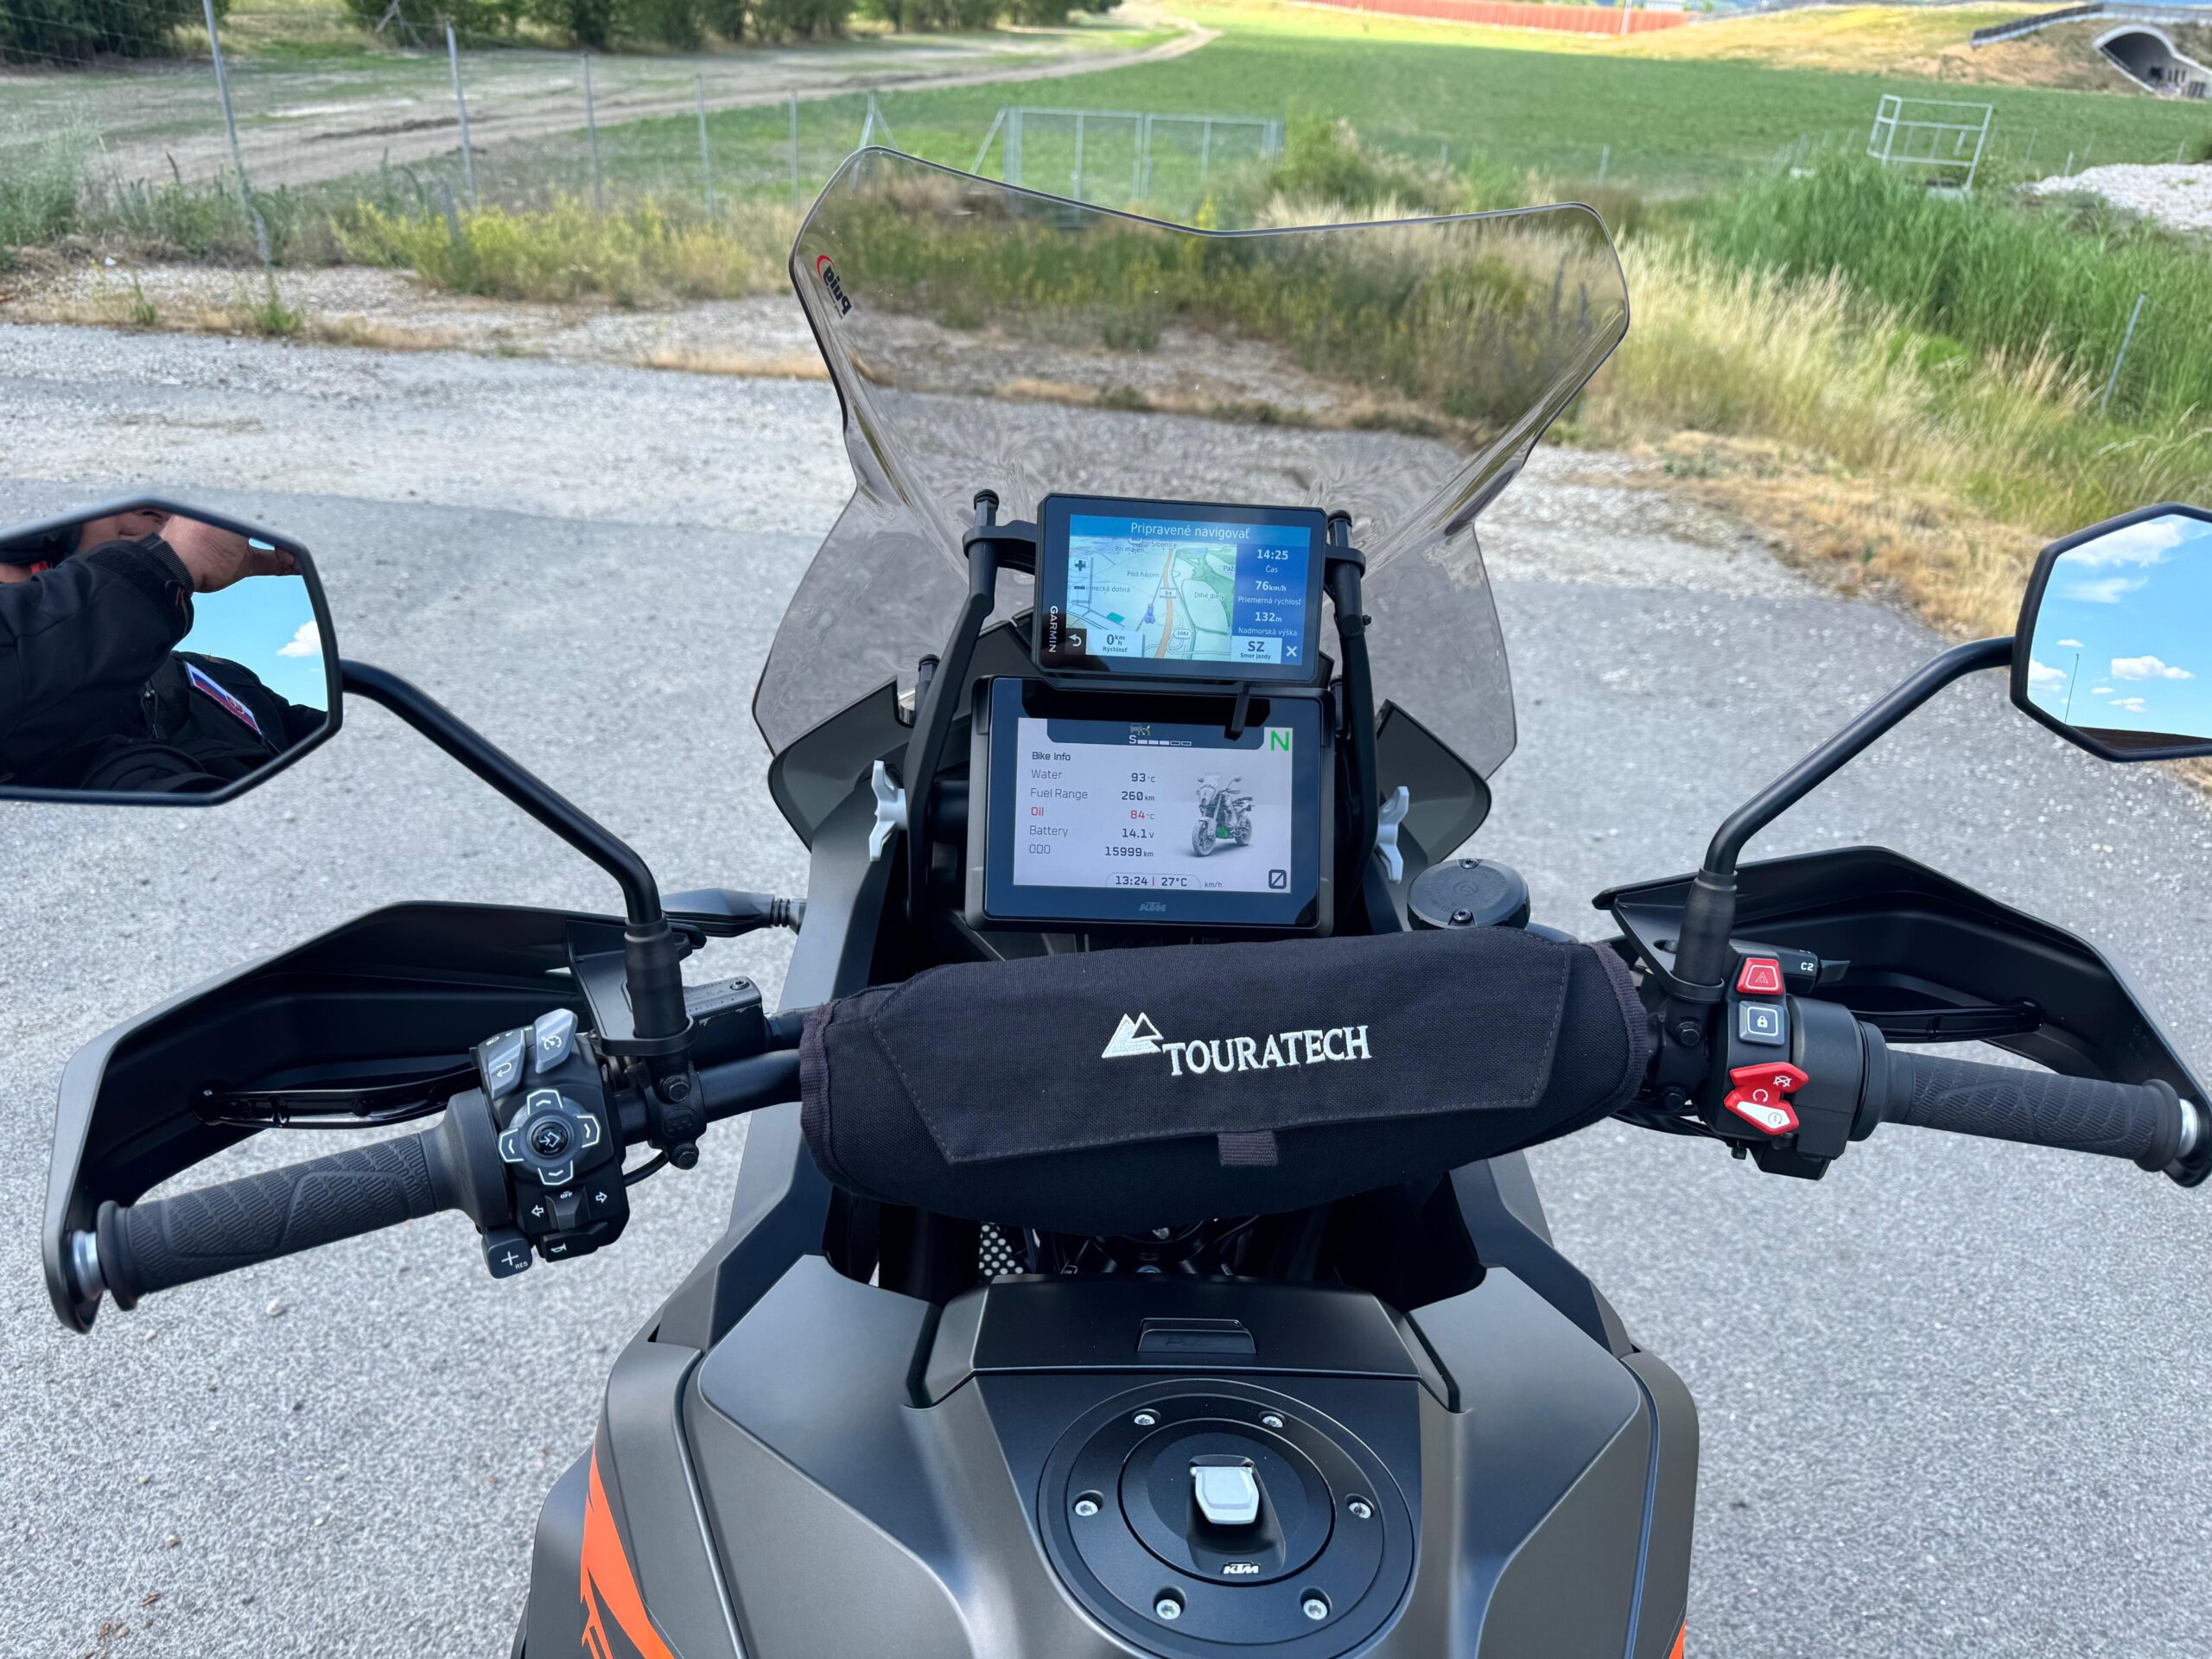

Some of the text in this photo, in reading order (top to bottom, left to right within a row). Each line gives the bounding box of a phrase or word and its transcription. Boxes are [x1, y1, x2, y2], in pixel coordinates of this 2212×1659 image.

[1131, 522, 1250, 540] Pripravené navigovať
[1256, 549, 1289, 560] 14:25
[1265, 564, 1279, 574] Čas
[1111, 585, 1131, 594] dolina
[1238, 595, 1273, 605] Priemerná
[1049, 605, 1058, 652] GARMIN
[1238, 627, 1298, 638] Nadmorská výška
[1106, 633, 1115, 645] 0
[1248, 640, 1265, 652] SZ
[1128, 734, 1137, 744] S
[1270, 731, 1290, 751] N
[1032, 751, 1071, 761] Bike Info
[1031, 769, 1063, 779] Water
[1131, 772, 1146, 782] 93
[1030, 787, 1052, 798] Fuel
[1054, 788, 1088, 800] Range
[1122, 791, 1143, 800] 260
[1031, 806, 1045, 817] Oil
[1130, 810, 1146, 819] 84
[1029, 825, 1069, 837] Battery
[1122, 828, 1147, 838] 14.1
[1105, 846, 1142, 857] 15999
[1115, 875, 1148, 886] 13:24
[1161, 877, 1187, 887] 27°C
[1139, 902, 1166, 912] KTM
[1801, 962, 1814, 971] C2
[1162, 1025, 1373, 1077] TOURATECH
[1223, 1563, 1259, 1574] KTM
